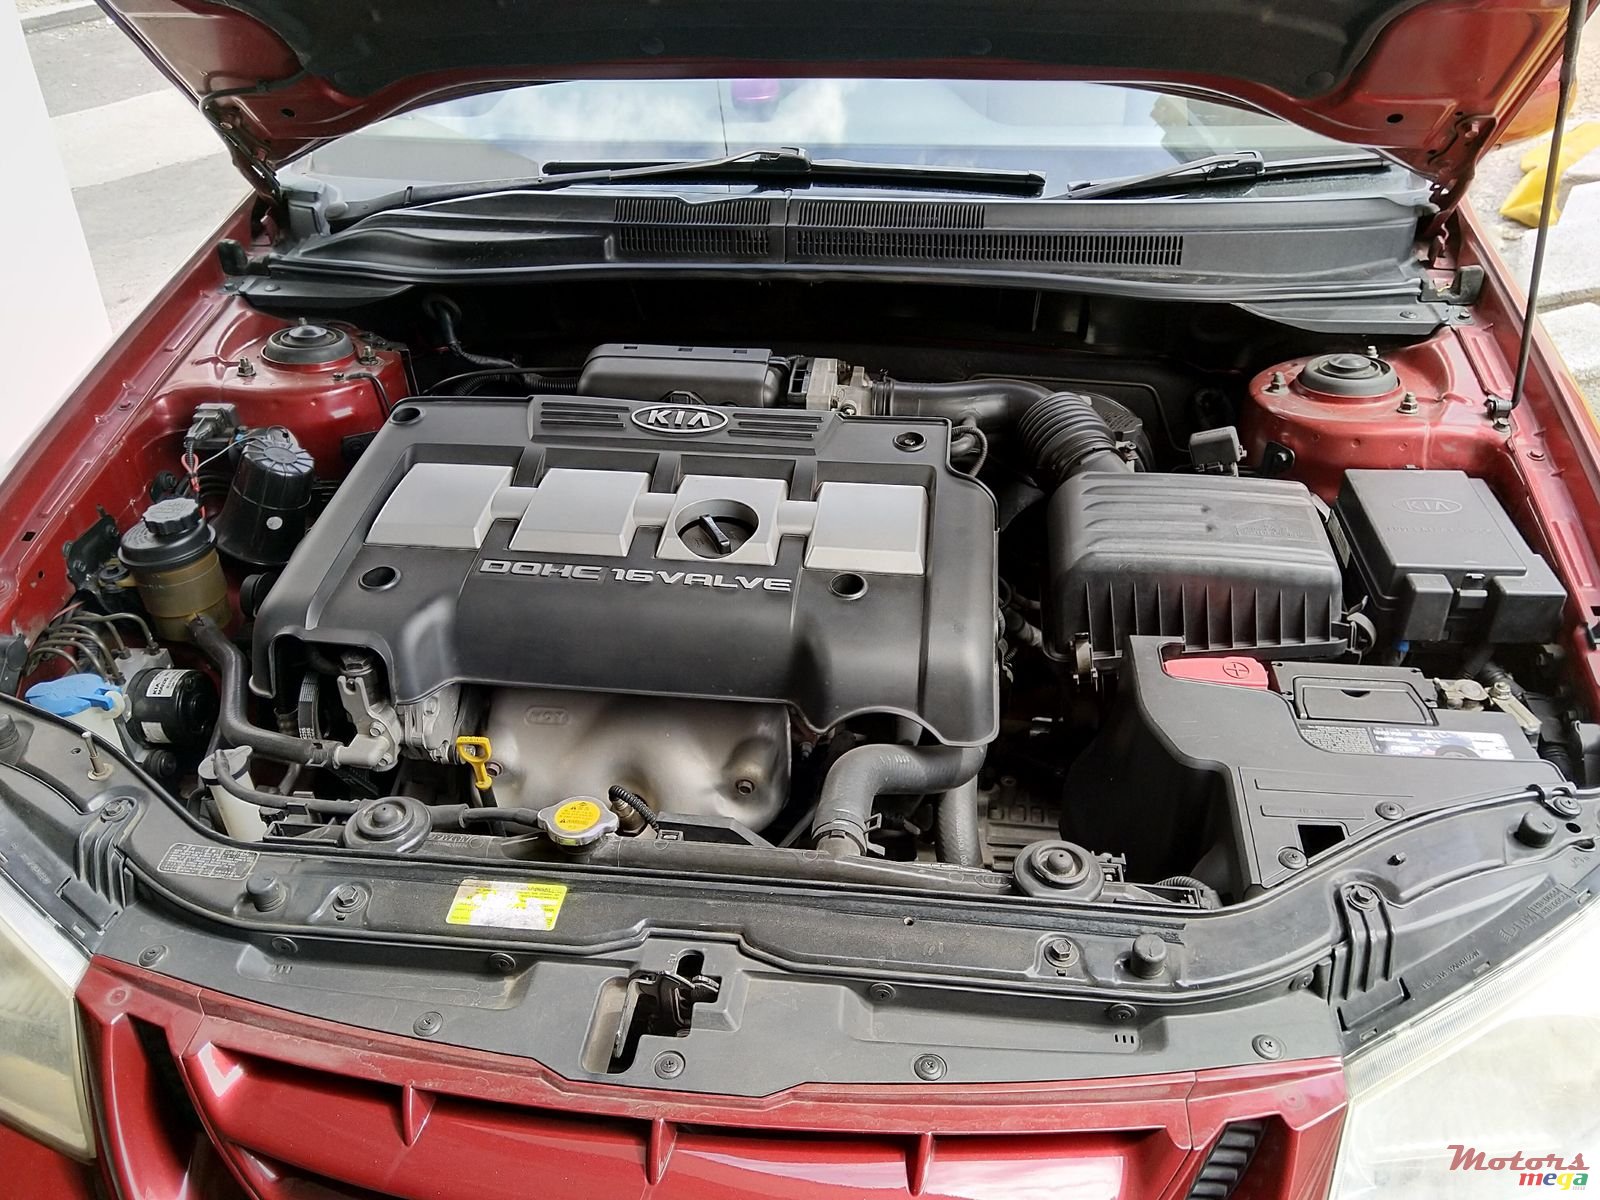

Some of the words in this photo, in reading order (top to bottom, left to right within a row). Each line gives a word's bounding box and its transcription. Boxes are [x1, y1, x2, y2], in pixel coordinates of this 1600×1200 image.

[647, 409, 711, 427] KIA
[1403, 500, 1450, 511] KIA
[479, 559, 603, 581] DOHC
